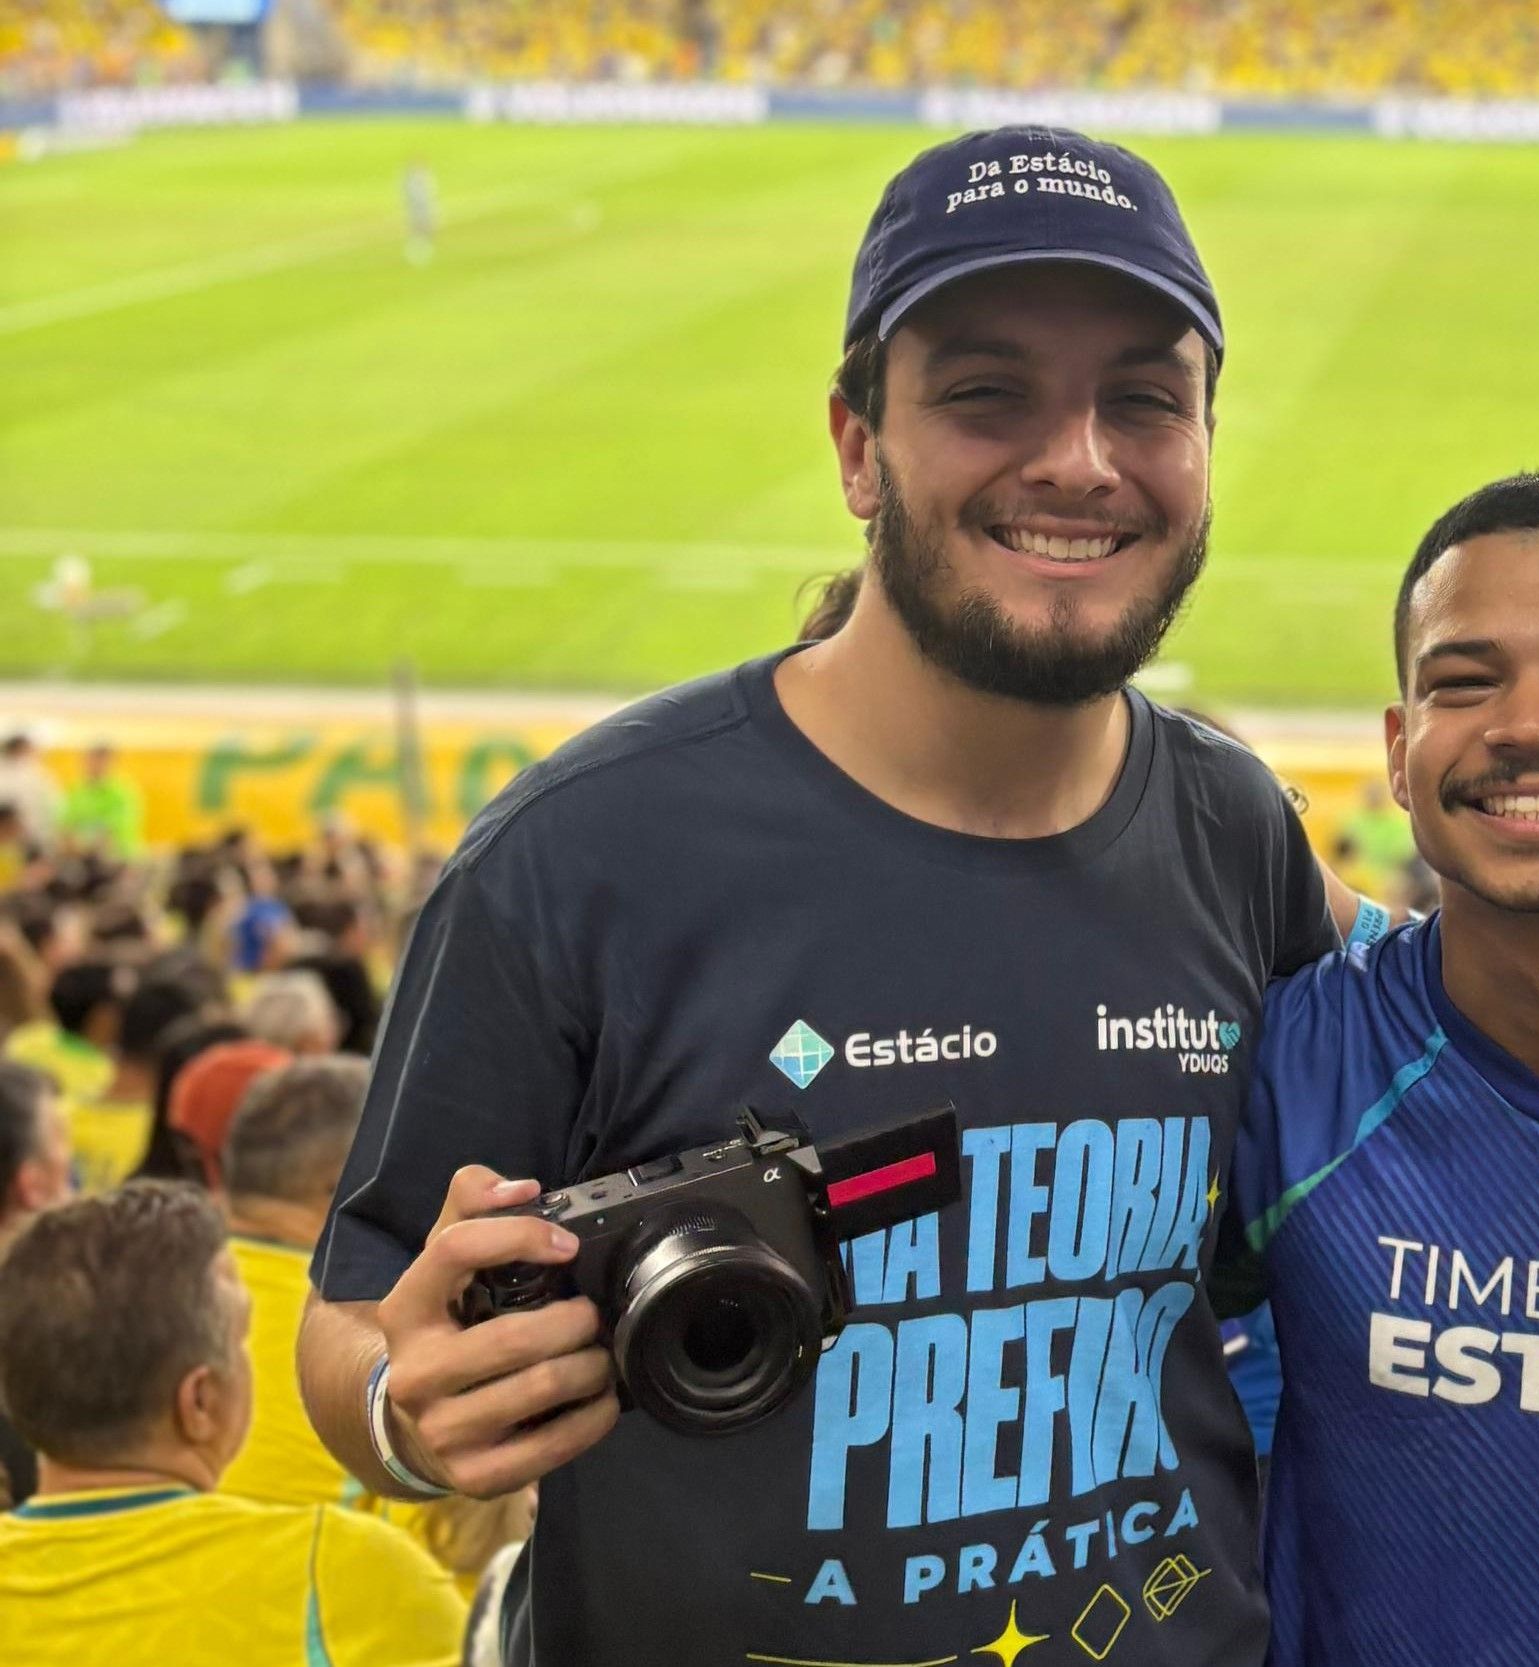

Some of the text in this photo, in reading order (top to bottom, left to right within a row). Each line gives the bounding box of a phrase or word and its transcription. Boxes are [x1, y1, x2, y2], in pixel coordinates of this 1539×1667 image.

[968, 152, 1112, 185] Da Estácio
[946, 177, 1138, 214] para o mundo.
[845, 1025, 997, 1067] Estácio
[1178, 1053, 1230, 1075] YDUQS
[803, 1487, 1201, 1606] A PRÁTICA
